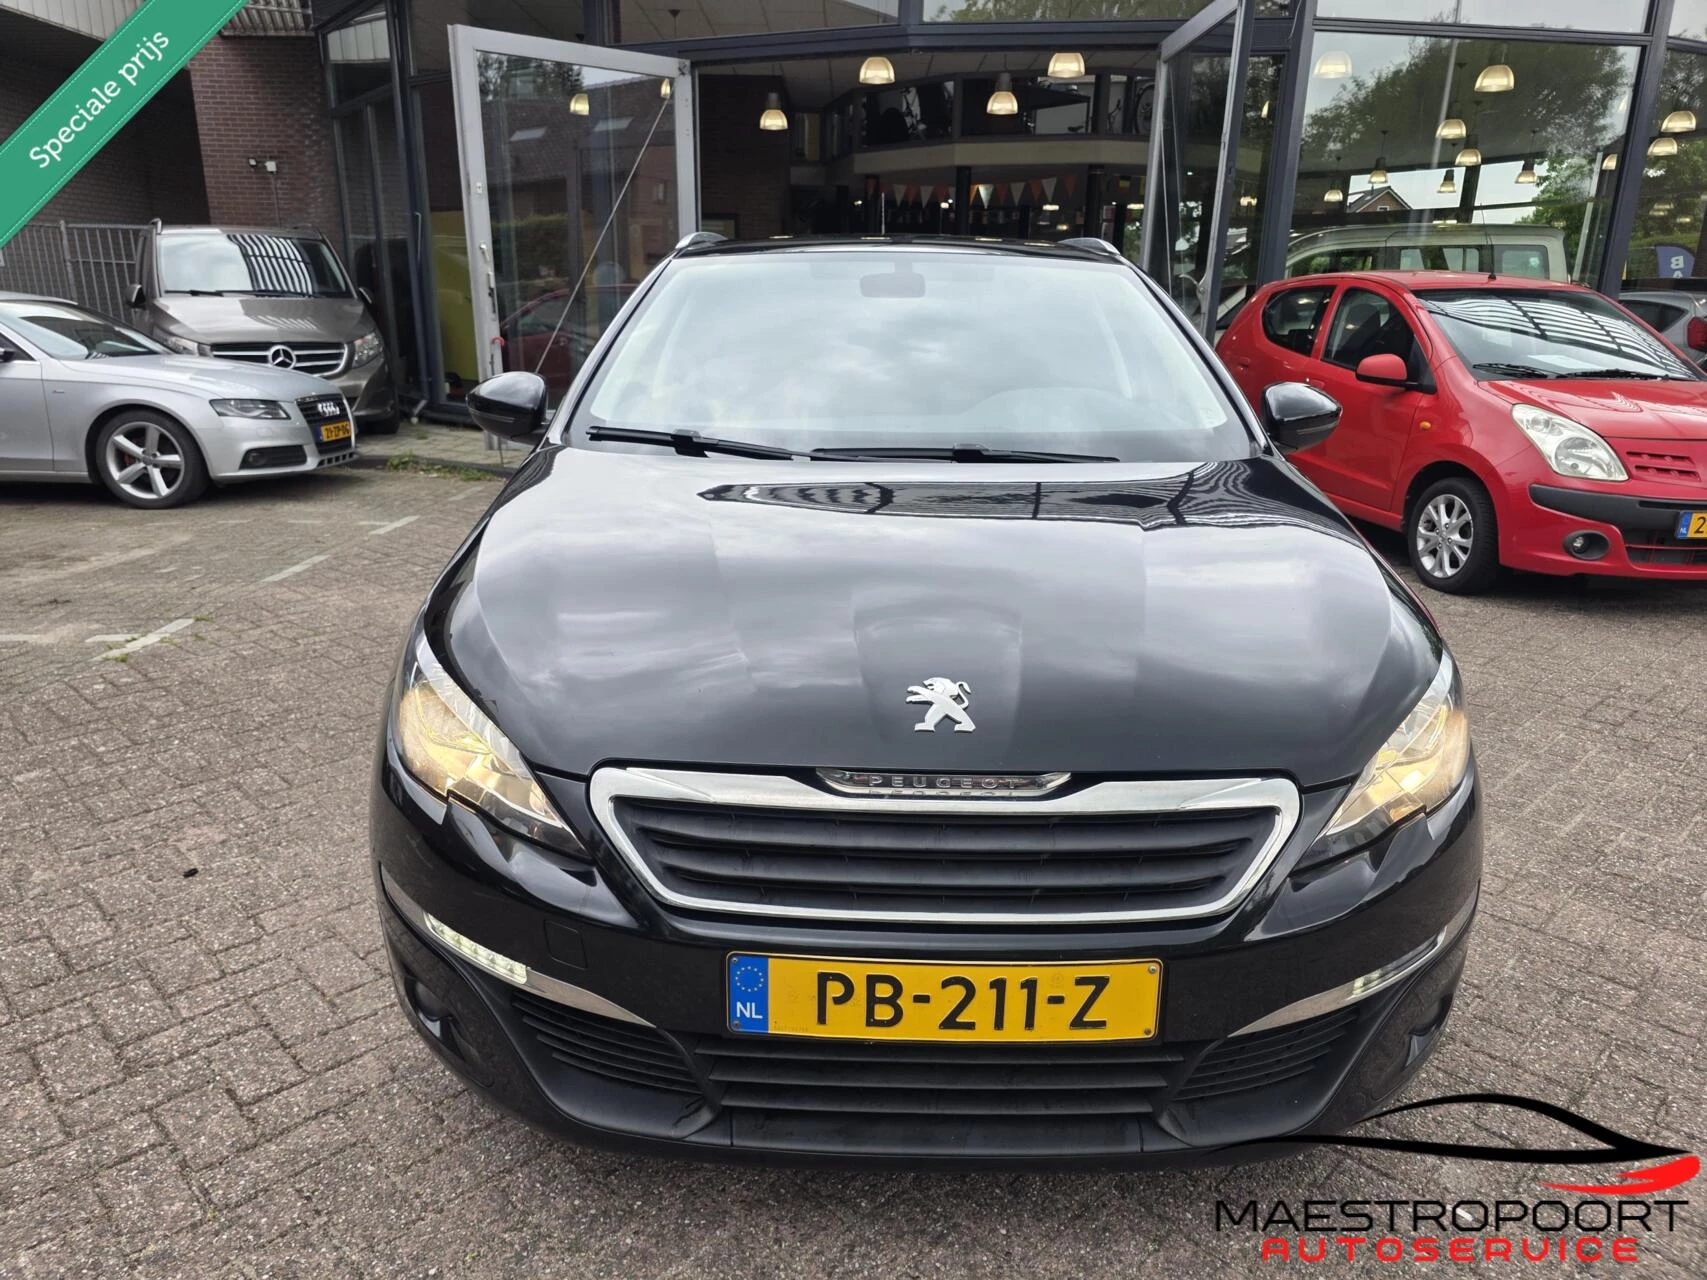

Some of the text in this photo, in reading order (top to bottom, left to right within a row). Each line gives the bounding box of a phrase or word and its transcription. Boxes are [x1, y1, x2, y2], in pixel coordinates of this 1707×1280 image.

[868, 776, 1021, 789] PEUGEOT
[735, 971, 1111, 1031] NL PB-211-Z
